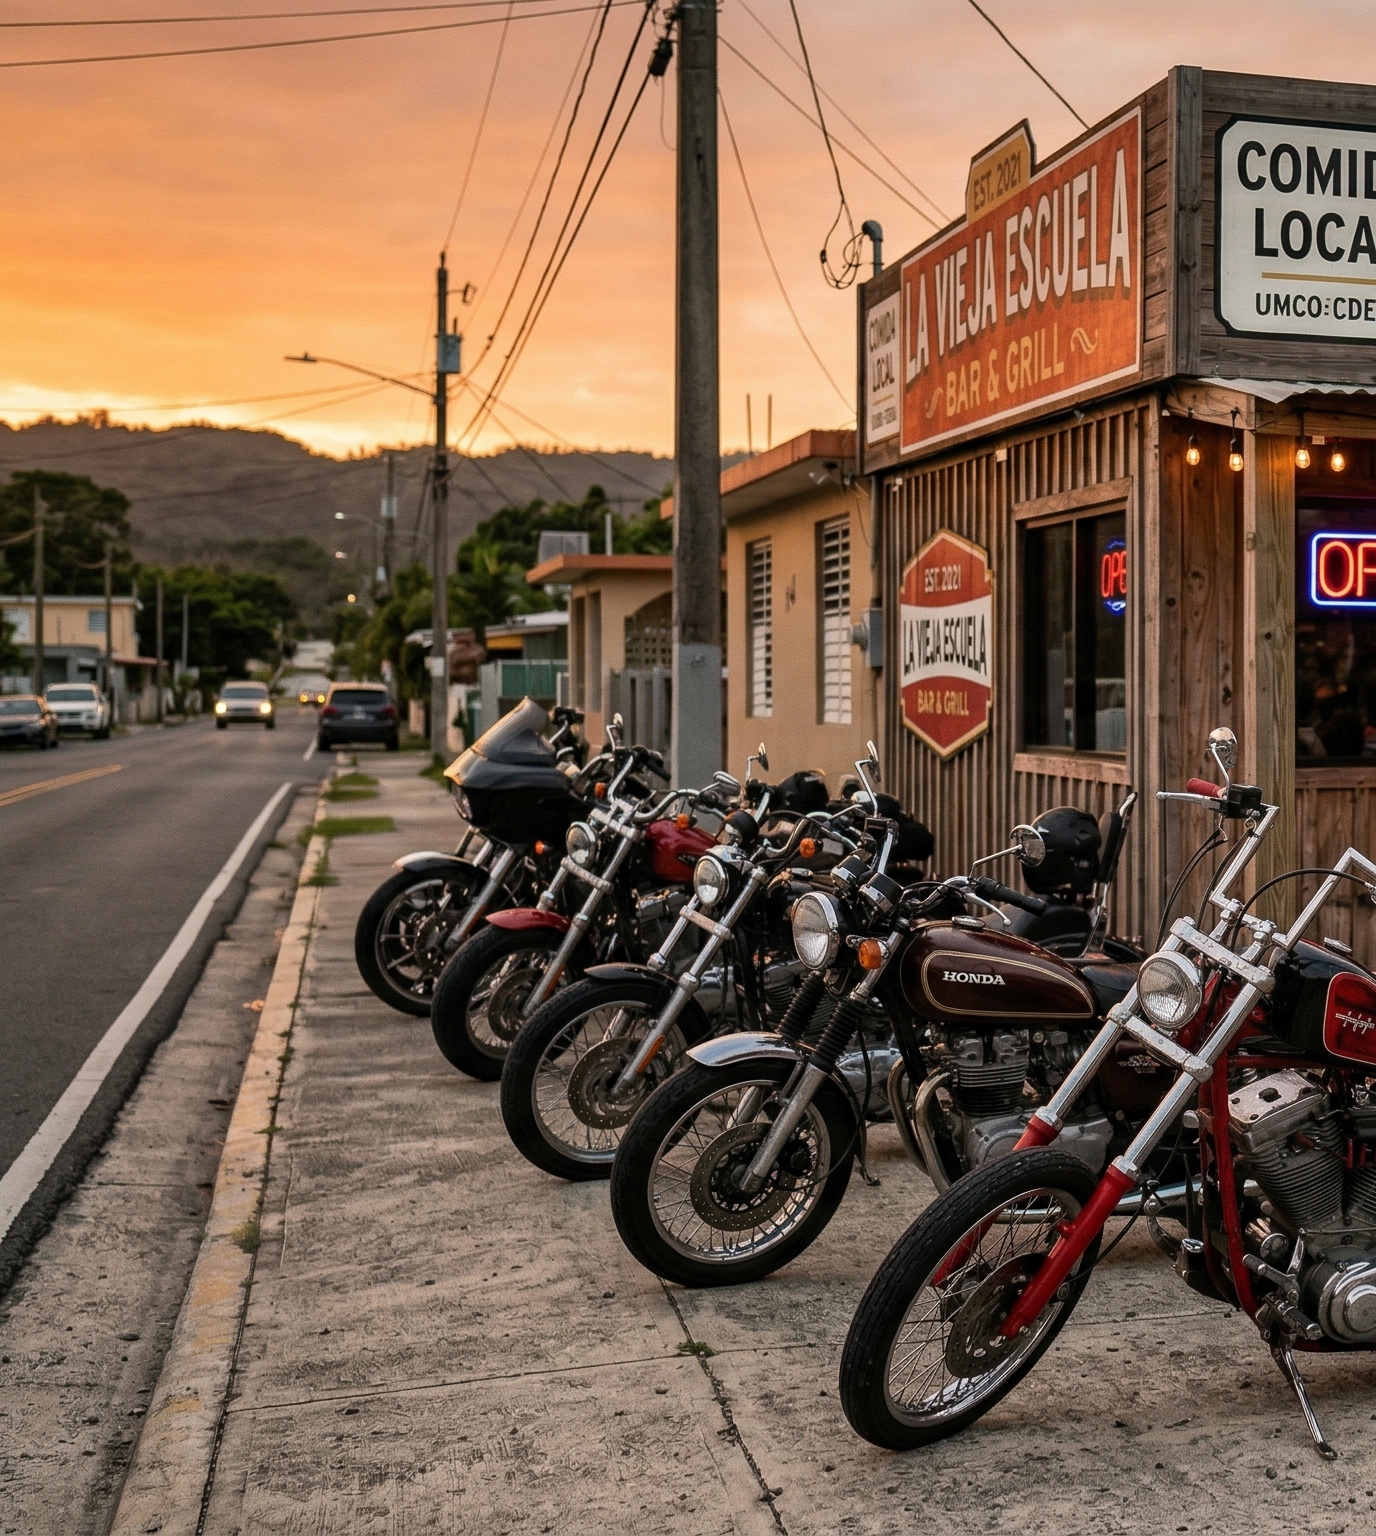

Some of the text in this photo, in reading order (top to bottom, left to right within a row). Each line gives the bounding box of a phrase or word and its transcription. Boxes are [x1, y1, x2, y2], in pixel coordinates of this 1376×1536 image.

[973, 149, 1022, 212] EST. 2021
[905, 147, 1132, 386] LA VIEJA ESCUELA
[946, 322, 1065, 418] BAR & GRILL
[942, 564, 961, 591] 2021
[1102, 550, 1127, 598] OPE
[903, 613, 987, 677] LA VIEJA ESCUELA
[918, 689, 934, 714] BAR
[944, 690, 969, 717] GRILL
[942, 971, 1006, 985] HONDA
